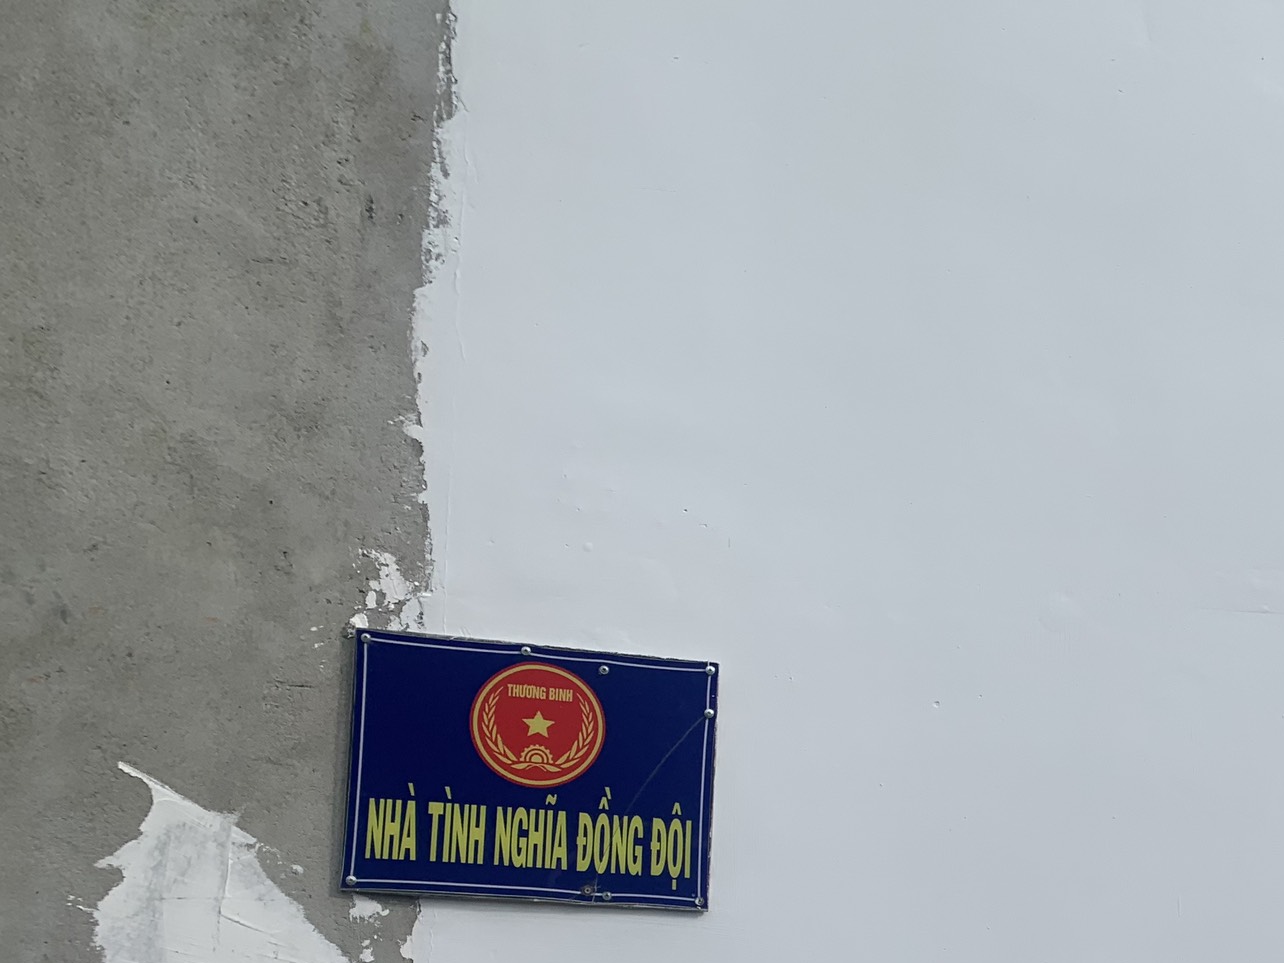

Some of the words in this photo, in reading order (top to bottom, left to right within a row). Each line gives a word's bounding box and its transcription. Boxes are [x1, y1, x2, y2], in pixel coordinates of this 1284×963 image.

[549, 688, 573, 702] BINH
[364, 782, 417, 861] NHÀ
[428, 786, 487, 865] TÌNH
[493, 793, 568, 871] NGHĨA
[577, 786, 644, 877] ĐỒNG
[650, 802, 693, 891] ĐỘI
